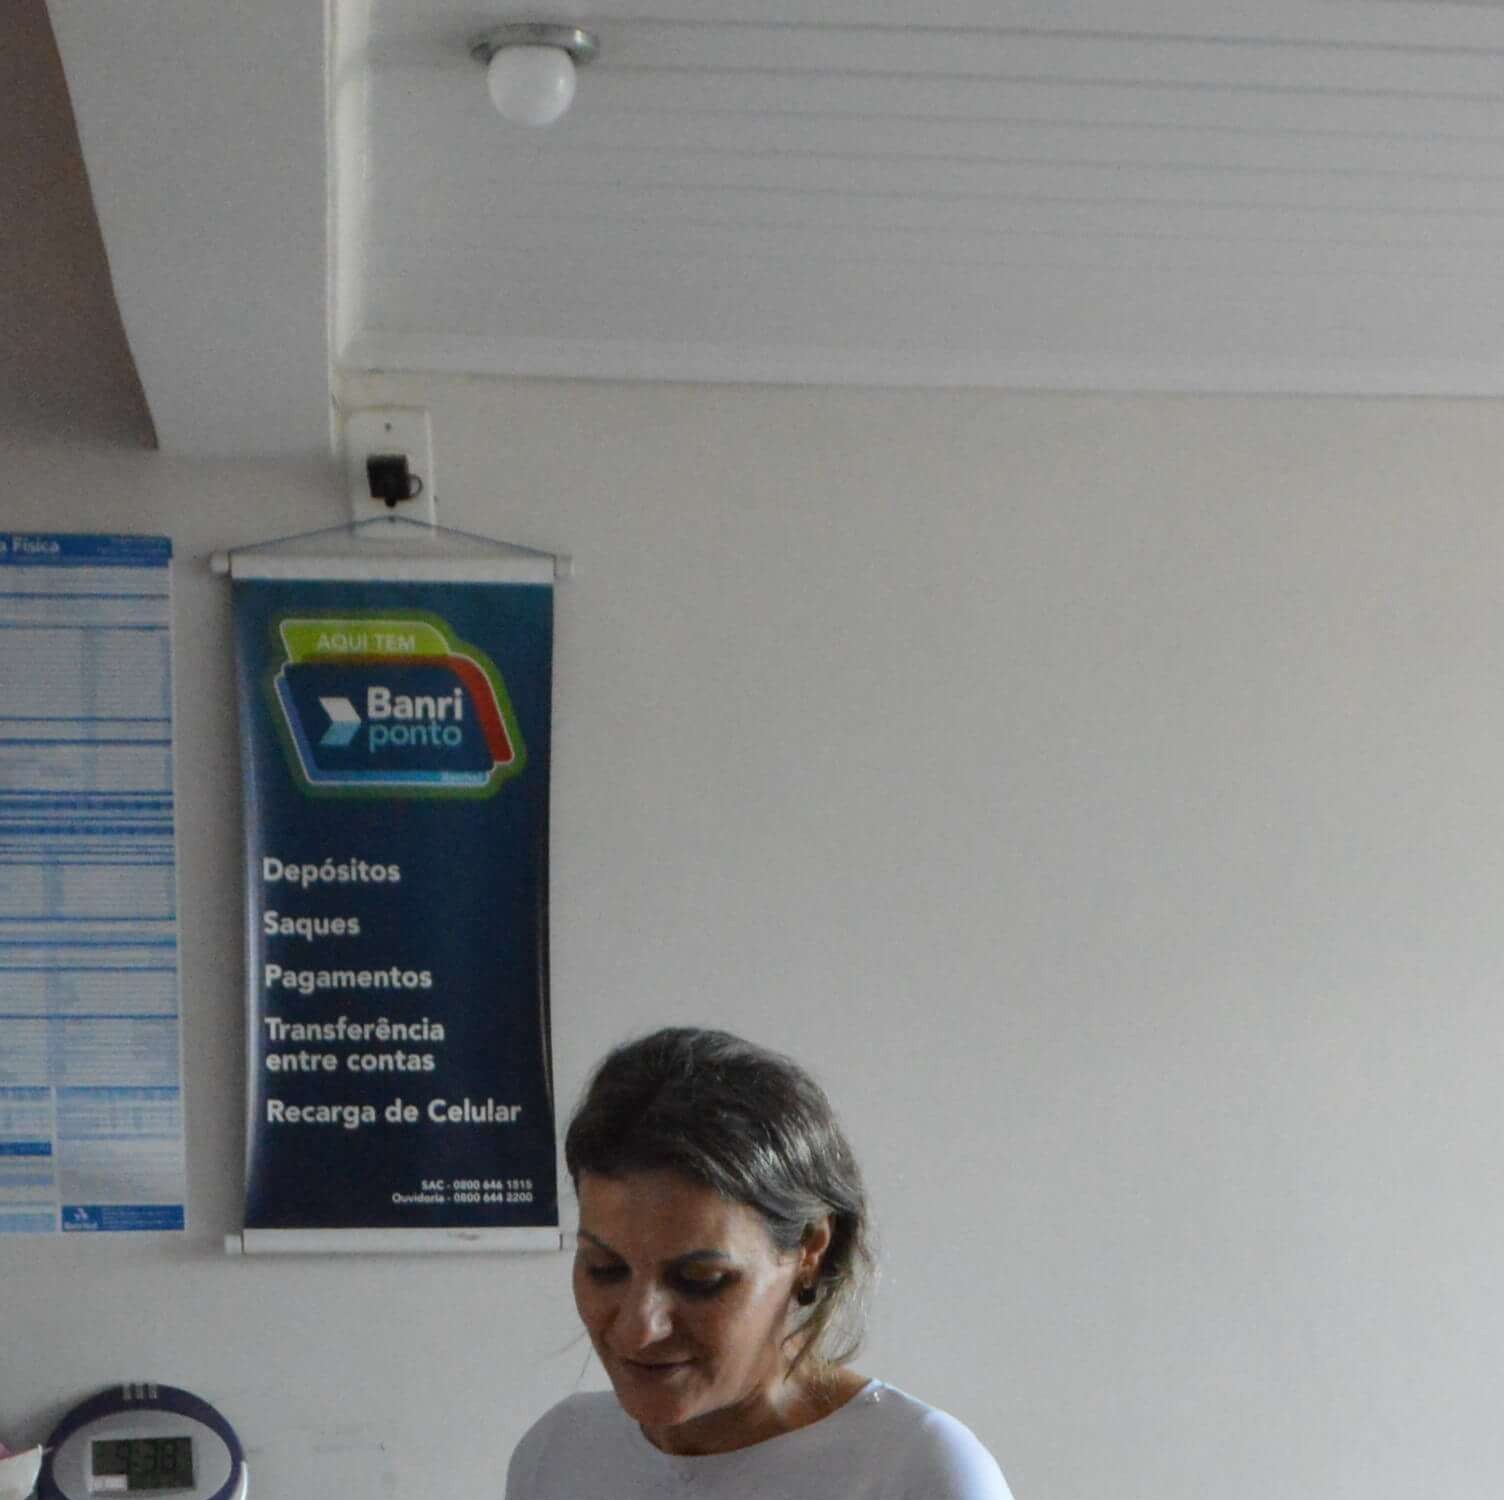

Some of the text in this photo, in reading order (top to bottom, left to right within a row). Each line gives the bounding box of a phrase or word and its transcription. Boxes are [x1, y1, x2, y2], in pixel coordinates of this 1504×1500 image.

[12, 536, 61, 553] Física
[316, 634, 416, 652] AQUI TEM
[367, 686, 463, 720] Banri
[368, 720, 462, 752] ponto
[262, 857, 401, 888] Depósitos
[262, 910, 361, 942] Saques
[264, 963, 433, 994] Pagamentos
[264, 1015, 446, 1042] Transferência
[265, 1050, 436, 1072] entre contas
[266, 1097, 522, 1129] Recarga de Celular
[421, 1179, 445, 1191] SAC
[453, 1179, 481, 1191] 0800
[453, 1192, 481, 1204] 0800
